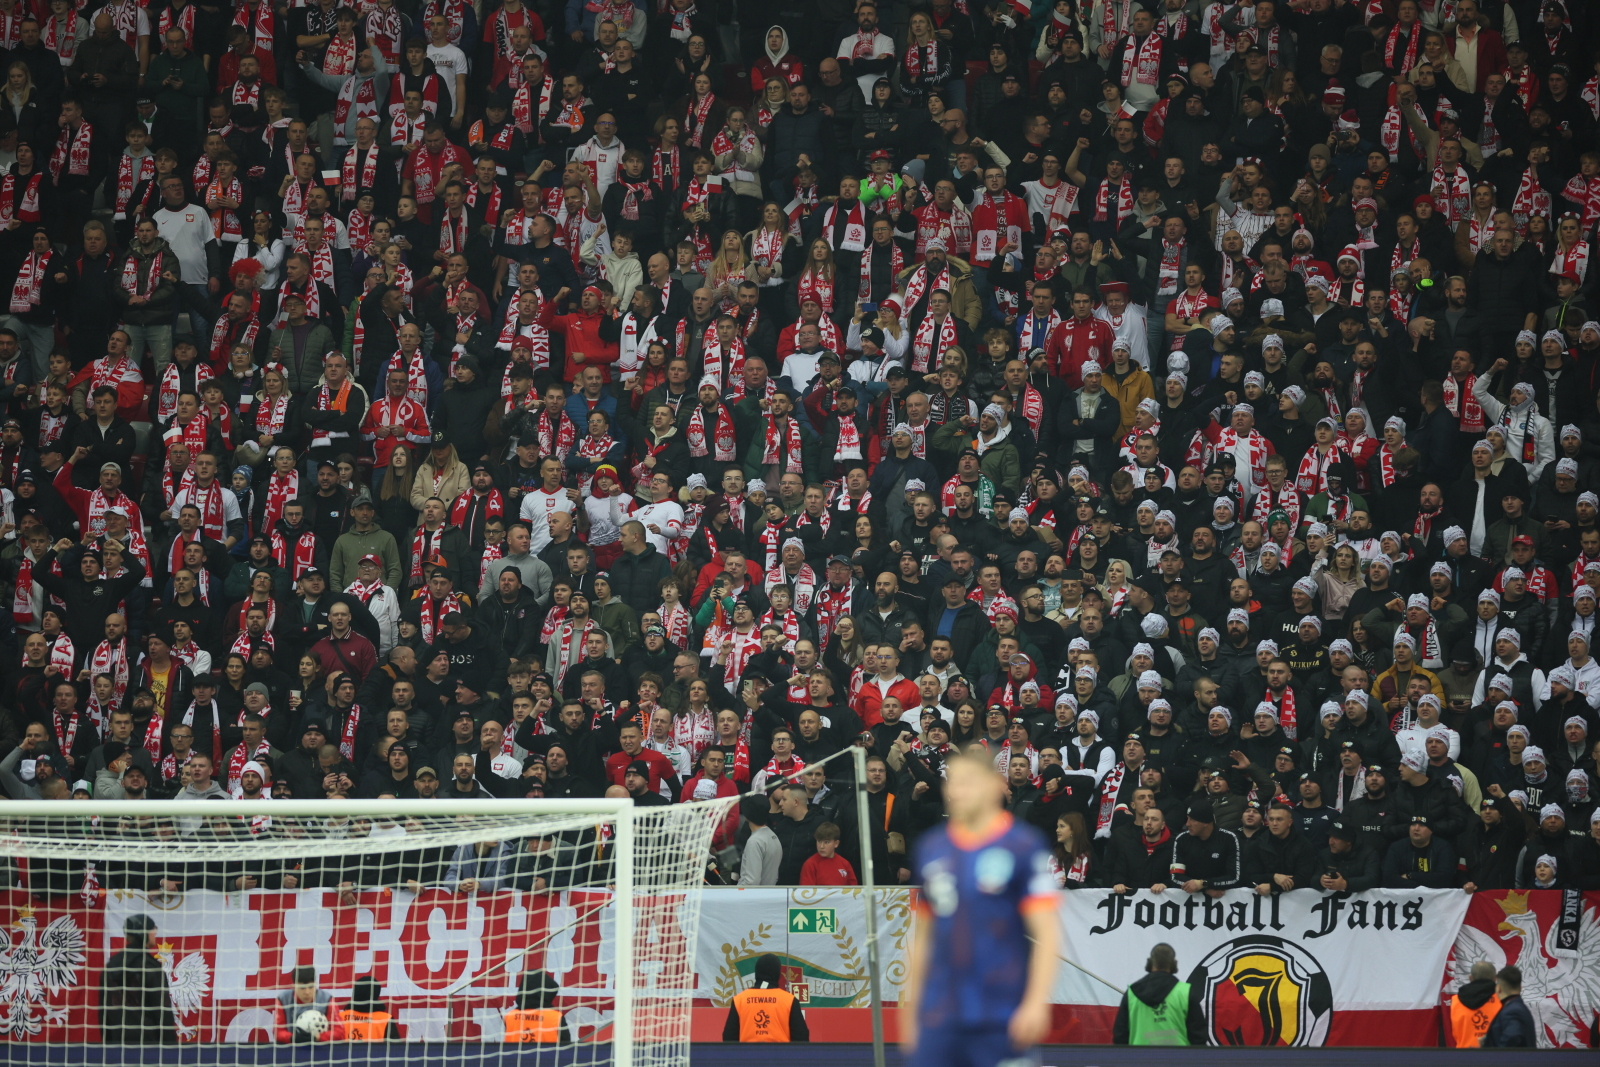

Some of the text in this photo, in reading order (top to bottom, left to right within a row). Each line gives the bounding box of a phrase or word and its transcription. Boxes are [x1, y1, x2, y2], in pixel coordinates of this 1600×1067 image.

[1090, 888, 1424, 940] Football Fans
[805, 978, 859, 997] LECHIA
[746, 996, 777, 1004] STEWARD
[514, 1013, 545, 1022] STEWARD
